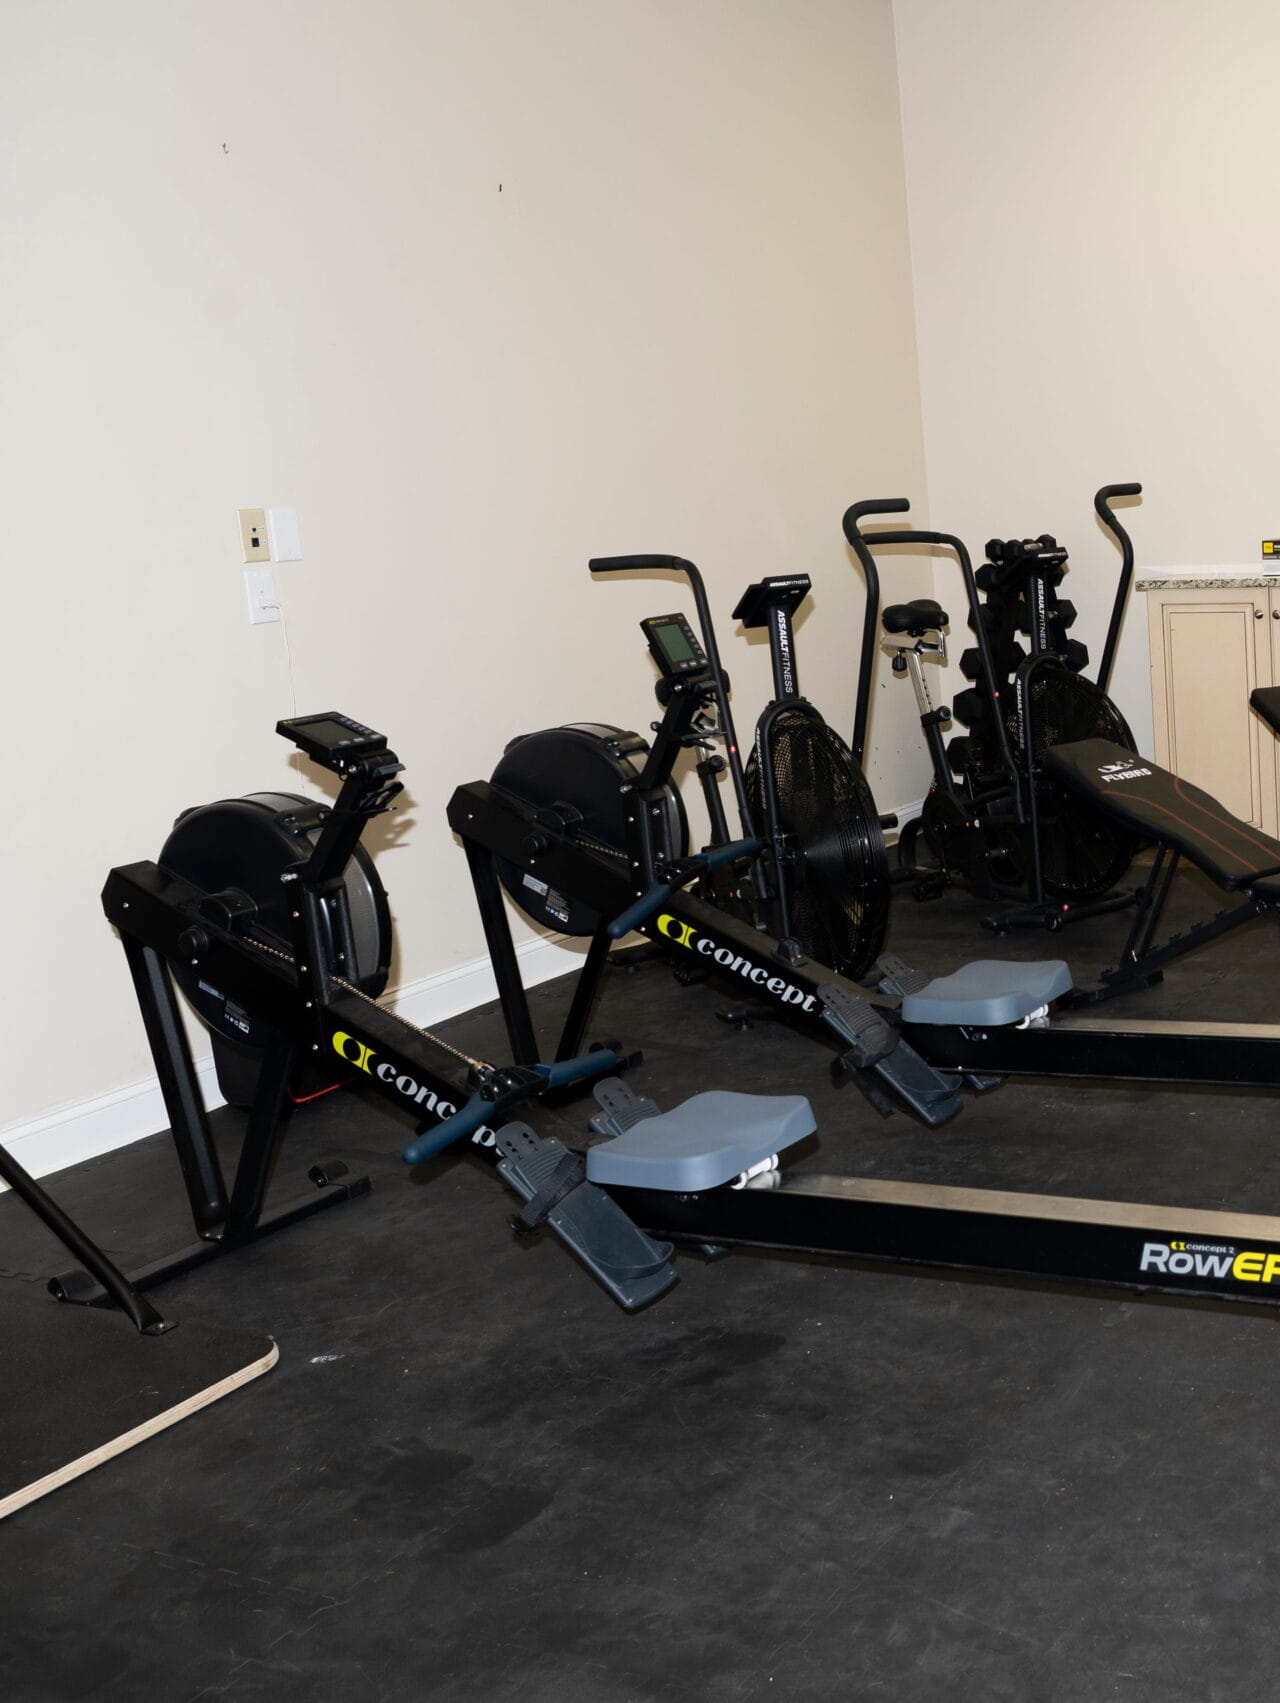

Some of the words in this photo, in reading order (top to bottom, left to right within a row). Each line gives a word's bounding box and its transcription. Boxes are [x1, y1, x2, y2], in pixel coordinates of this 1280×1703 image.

[1101, 768, 1153, 783] FLYBIRD
[696, 938, 818, 1013] concept
[1186, 1243, 1227, 1254] concept
[1228, 1246, 1235, 1254] 2
